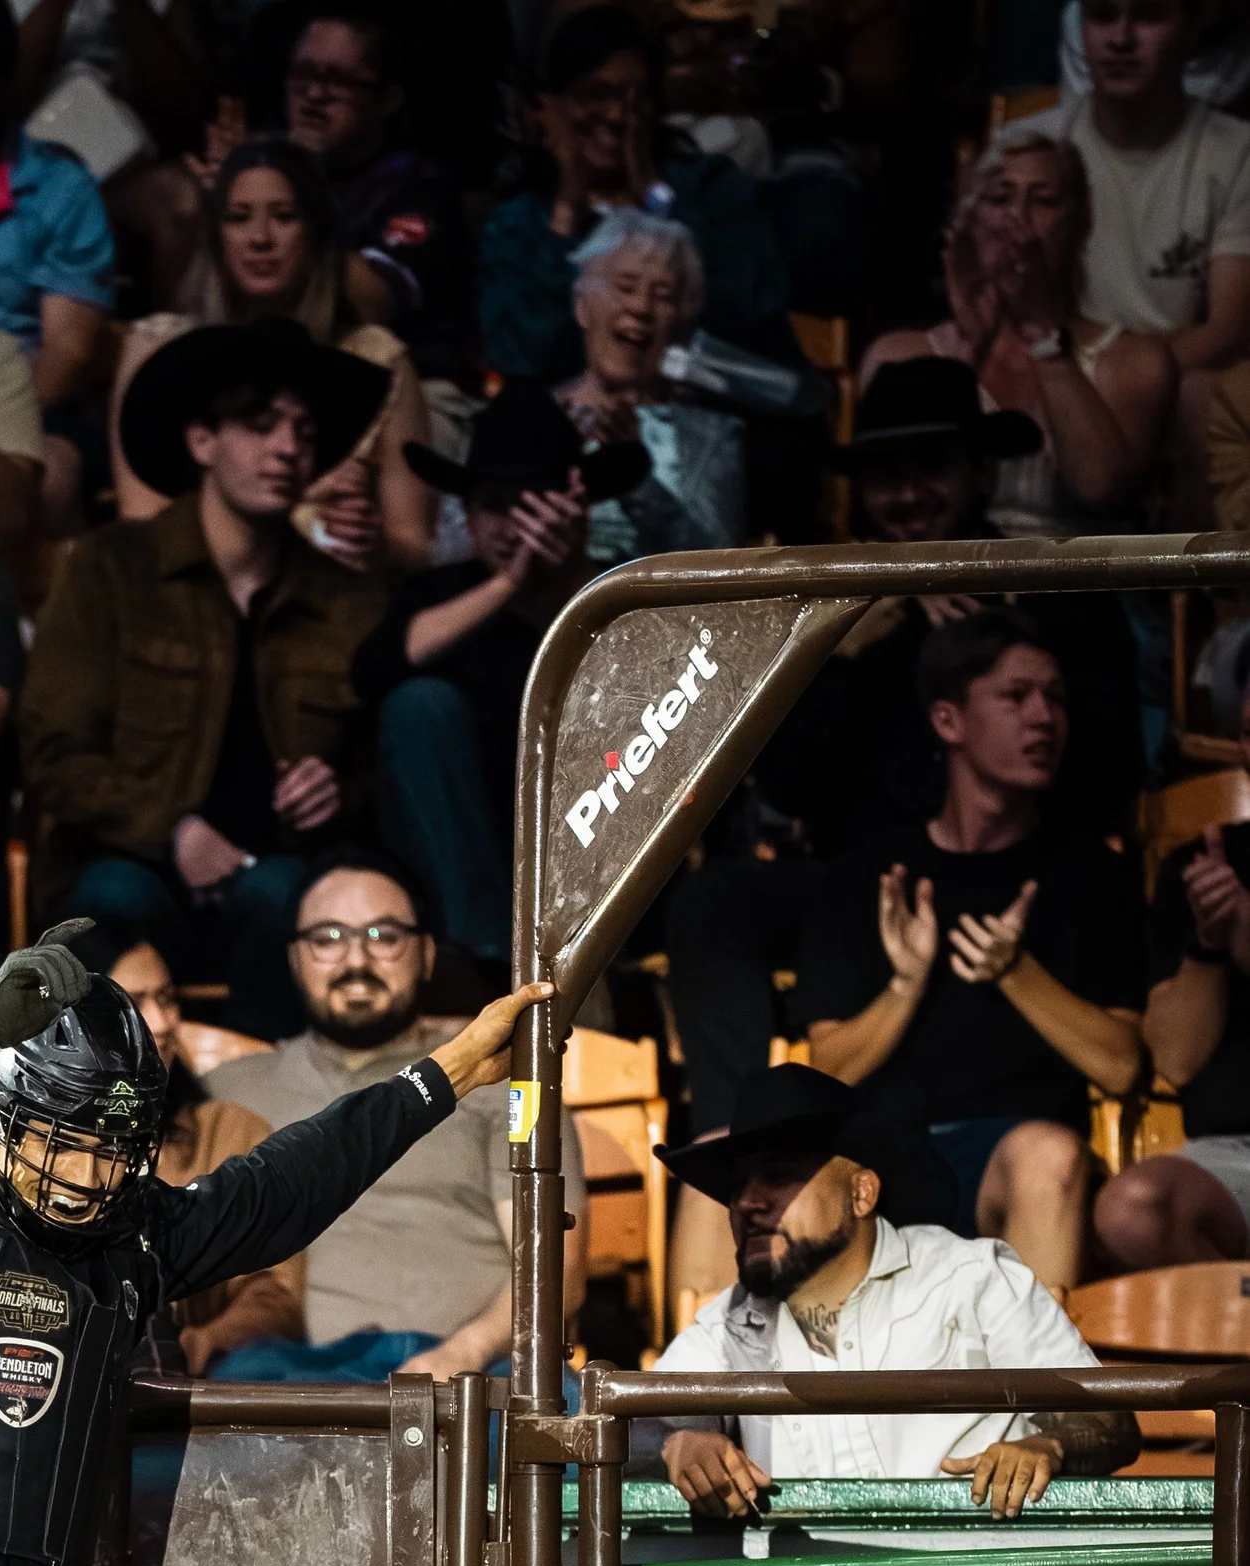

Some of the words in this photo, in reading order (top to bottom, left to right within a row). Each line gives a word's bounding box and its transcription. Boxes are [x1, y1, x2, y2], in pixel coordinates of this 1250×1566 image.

[565, 645, 719, 849] Priefert
[32, 1295, 65, 1314] FINALS
[1, 1371, 43, 1384] WHISKY
